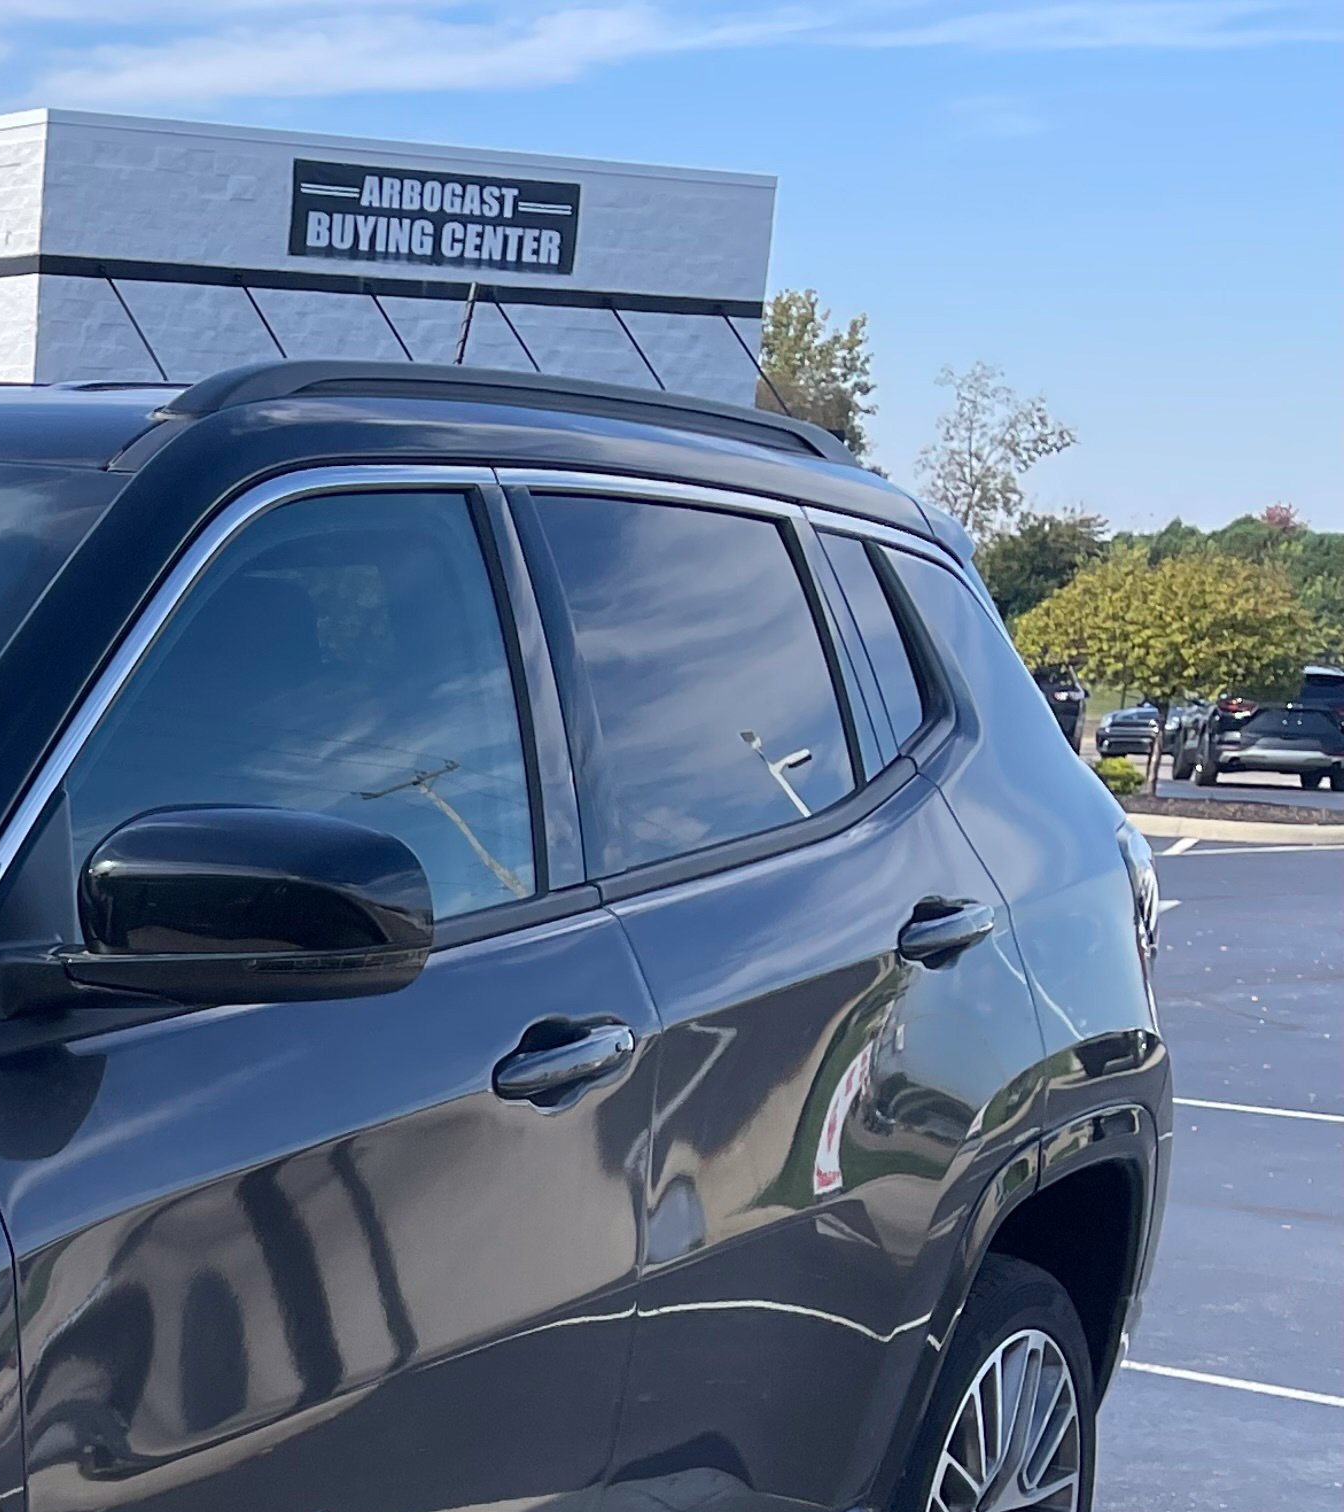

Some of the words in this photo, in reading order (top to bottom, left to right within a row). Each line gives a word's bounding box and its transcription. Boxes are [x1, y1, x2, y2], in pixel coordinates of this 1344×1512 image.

[360, 175, 519, 218] ARBOGAST
[306, 210, 434, 256] BUYING
[440, 221, 561, 265] CENTER
